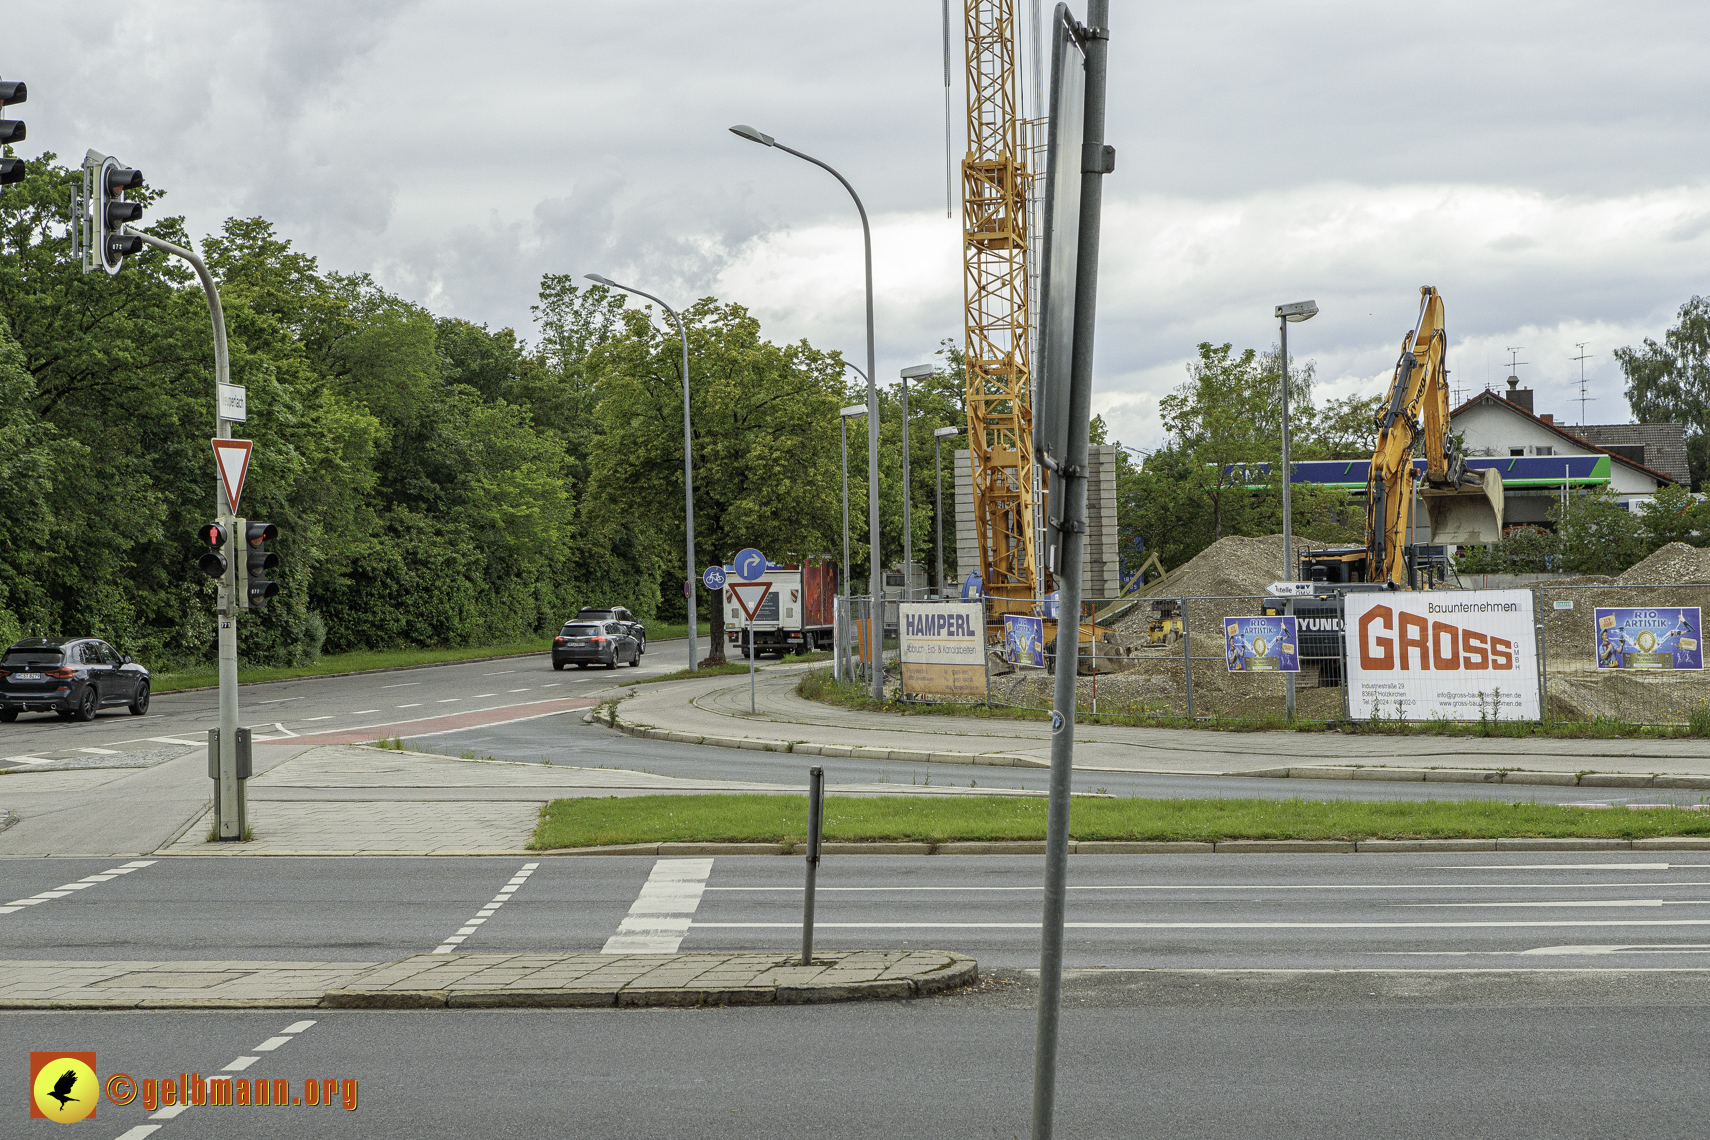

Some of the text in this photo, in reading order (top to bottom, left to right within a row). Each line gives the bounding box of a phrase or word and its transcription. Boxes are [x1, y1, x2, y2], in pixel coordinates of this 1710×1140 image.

[1428, 602, 1517, 614] Bauunternehmen
[1634, 610, 1657, 619] RIO
[906, 613, 976, 637] HAMPERL
[1250, 619, 1266, 627] RIO
[1624, 619, 1667, 628] ARTISTIK
[1244, 627, 1274, 635] ARTISTIK
[1358, 604, 1513, 671] GROSS
[1378, 690, 1407, 698] Holzkirchen
